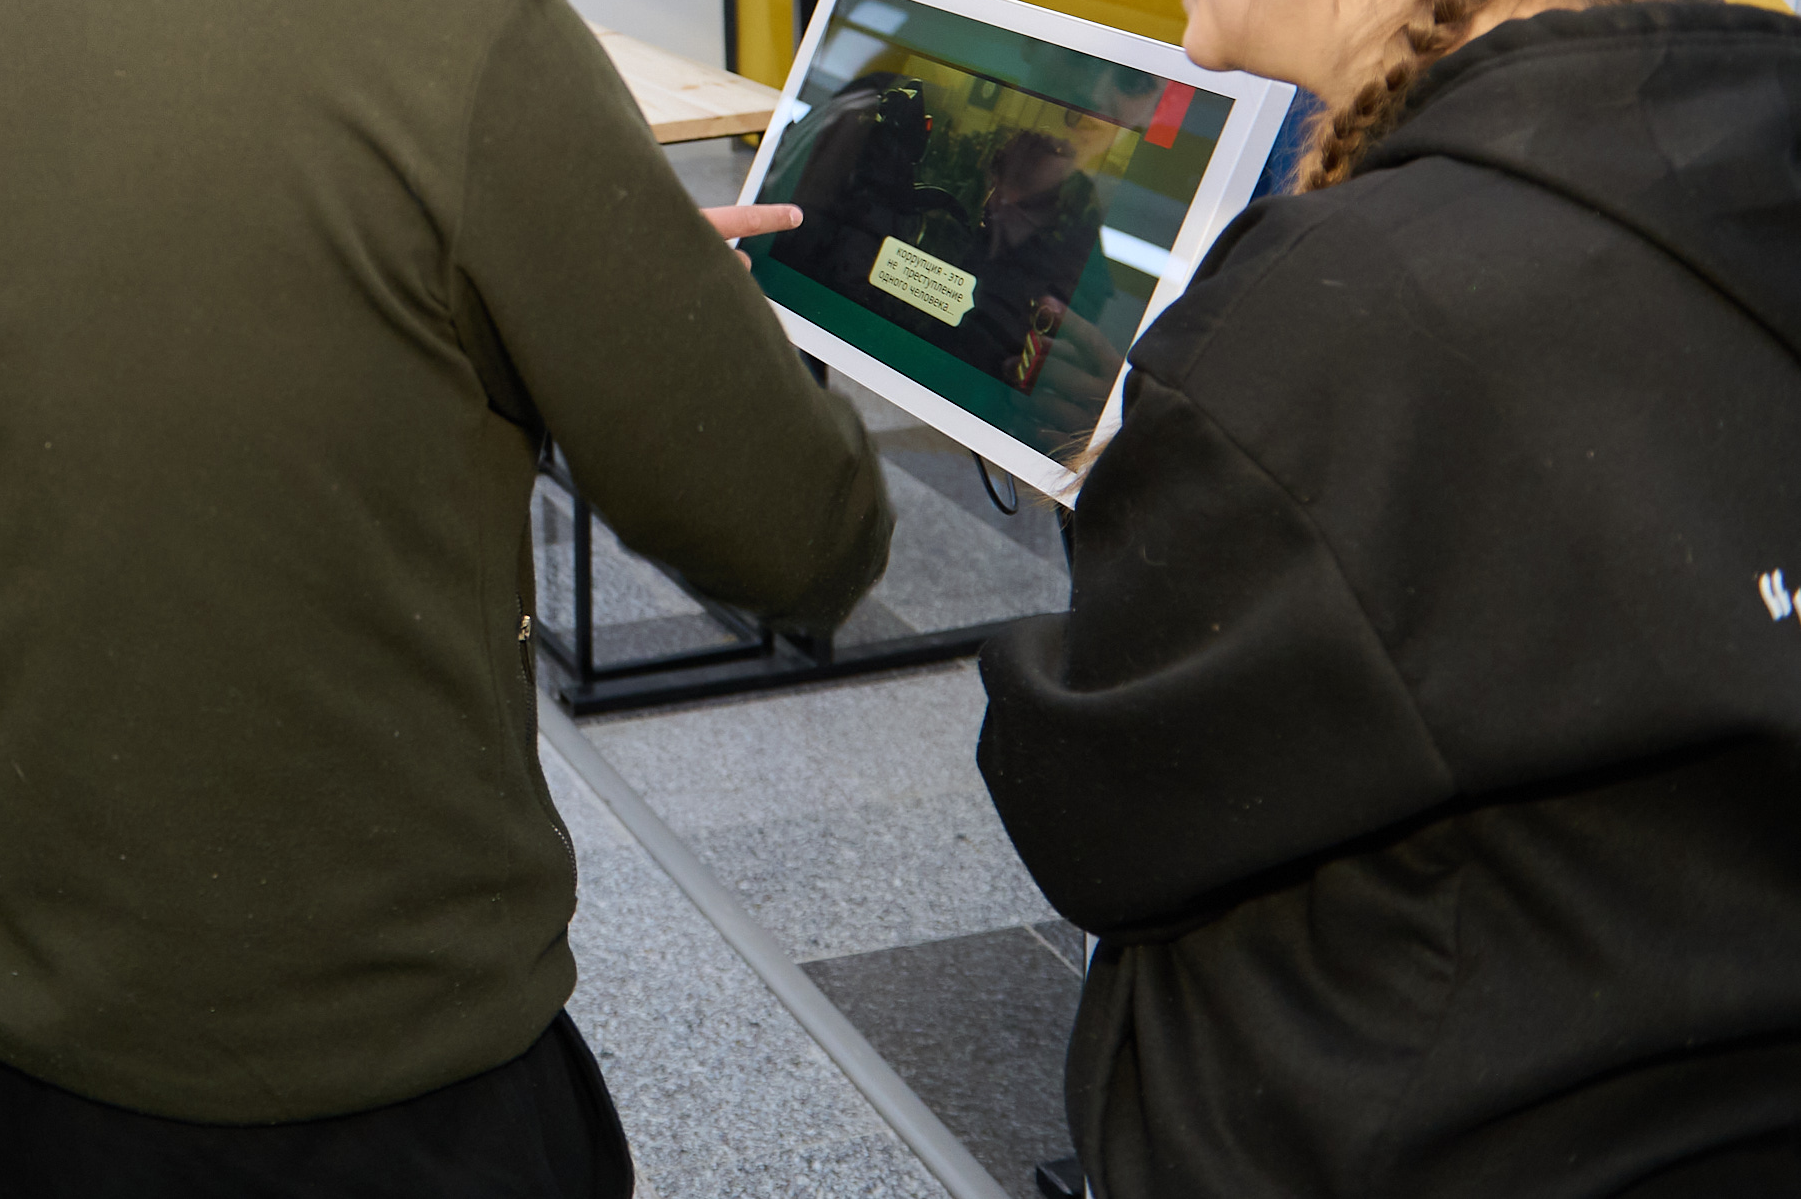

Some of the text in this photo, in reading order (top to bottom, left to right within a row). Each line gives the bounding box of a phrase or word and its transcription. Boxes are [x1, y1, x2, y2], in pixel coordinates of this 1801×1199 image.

[878, 269, 908, 291] одного
[887, 259, 964, 303] не преступление
[948, 272, 965, 287] это
